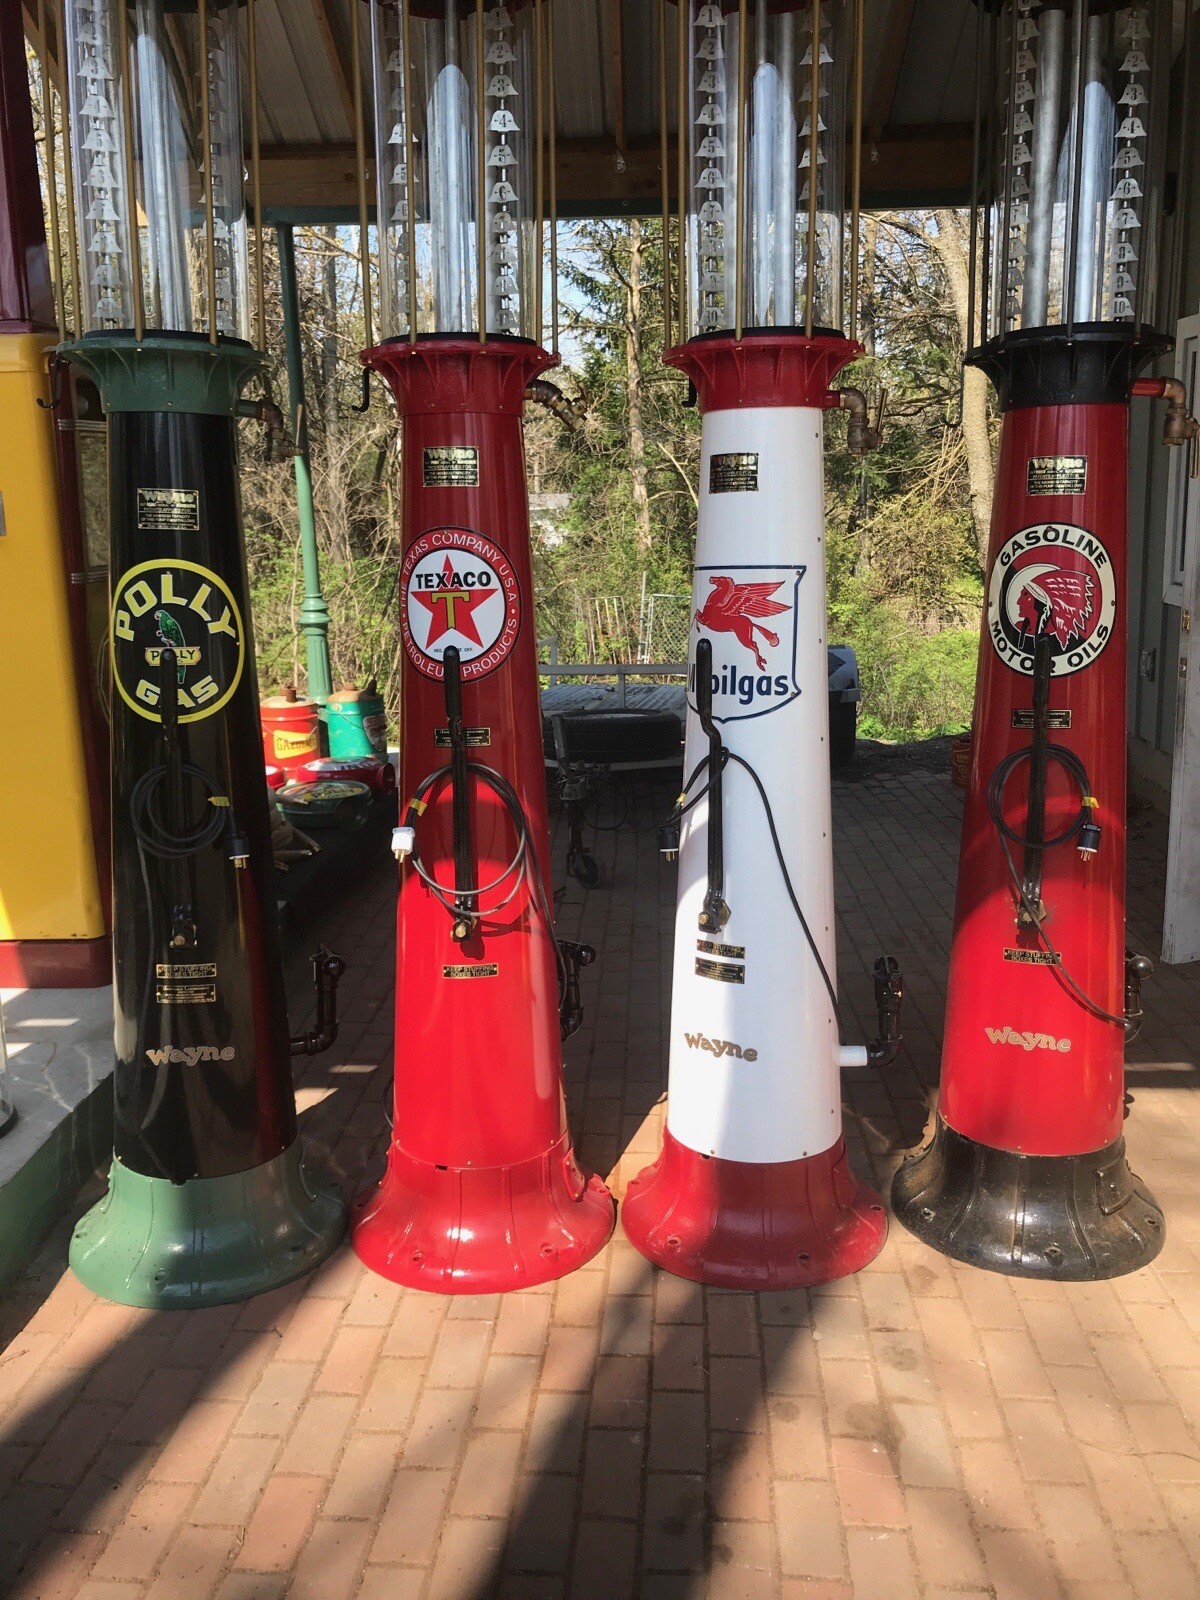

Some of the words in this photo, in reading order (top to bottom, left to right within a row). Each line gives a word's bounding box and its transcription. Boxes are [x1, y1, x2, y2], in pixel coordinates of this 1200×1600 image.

[708, 8, 713, 23] 1
[708, 41, 715, 55] 2
[1131, 54, 1139, 68] 2
[708, 75, 716, 89] 3
[1130, 86, 1138, 101] 3
[498, 114, 506, 128] 4
[708, 107, 715, 122] 4
[1127, 120, 1135, 134] 4
[708, 139, 715, 154] 5
[1123, 150, 1131, 165] 5
[707, 171, 715, 185] 6
[1122, 181, 1131, 195] 6
[1122, 212, 1129, 226] 7
[1118, 246, 1126, 260] 8
[1116, 275, 1124, 289] 9
[1113, 300, 1126, 314] 10
[1000, 526, 1107, 570] GASOLINE
[402, 539, 429, 576] TEXAS
[431, 533, 502, 563] COMPANY
[498, 563, 518, 606] U.S.A.
[415, 571, 492, 590] TEXACO
[115, 573, 237, 642] POLLY
[431, 590, 471, 631] T
[402, 621, 445, 677] PETROLEU
[463, 618, 518, 678] PRODUCTS
[991, 620, 1056, 674] MOTO
[1066, 624, 1110, 668] OILS
[150, 650, 196, 661] PLY
[688, 662, 790, 705] Mbilgas
[684, 1032, 759, 1062] Wayne
[984, 1026, 1073, 1053] Wayne
[145, 1044, 236, 1067] Wayne
